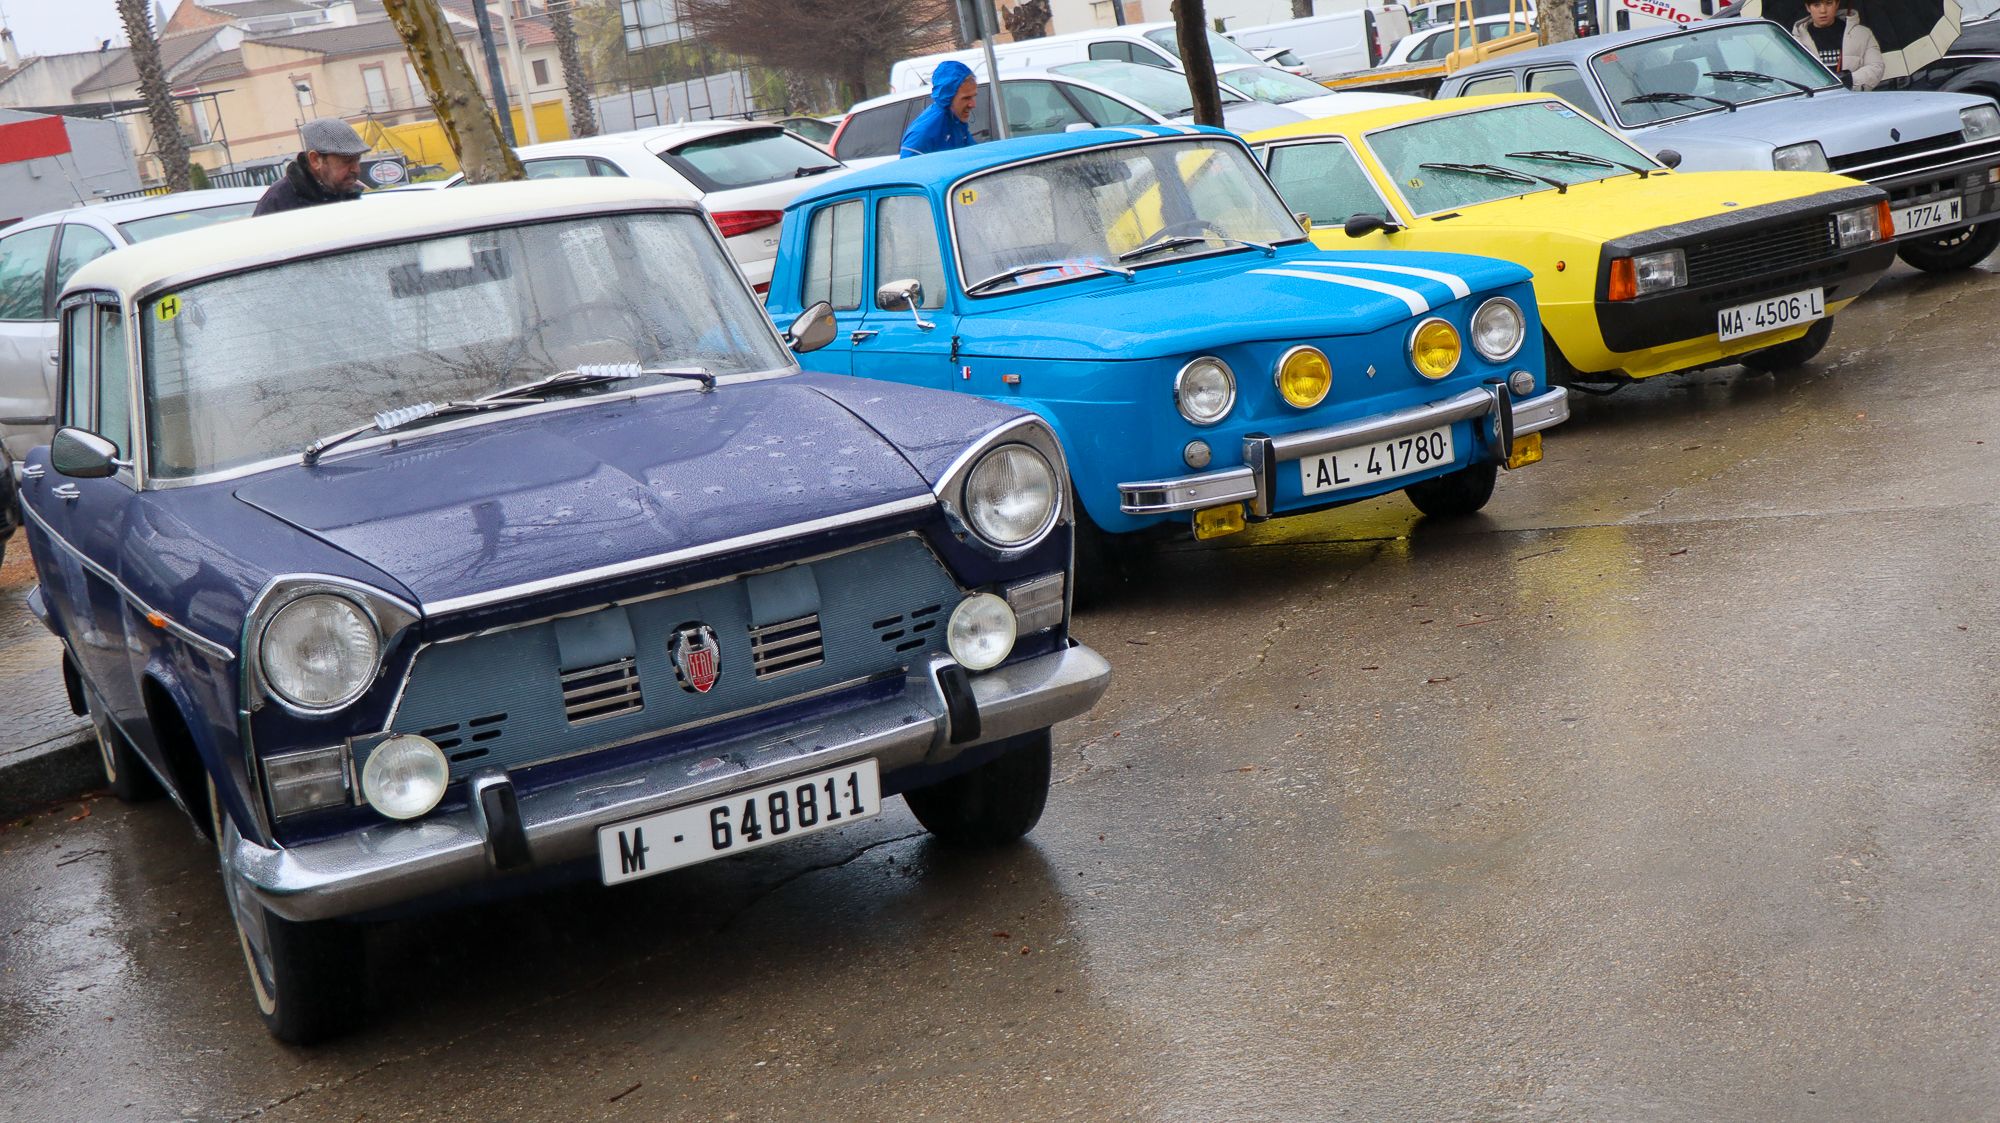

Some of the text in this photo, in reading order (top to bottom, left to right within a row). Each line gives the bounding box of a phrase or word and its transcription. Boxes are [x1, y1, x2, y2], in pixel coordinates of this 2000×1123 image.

[1411, 179, 1420, 188] H
[961, 191, 974, 204] H
[1906, 200, 1959, 229] 1774 W
[161, 298, 176, 319] H
[688, 650, 712, 678] SEAT
[618, 827, 647, 874] M
[709, 771, 864, 851] 648811
